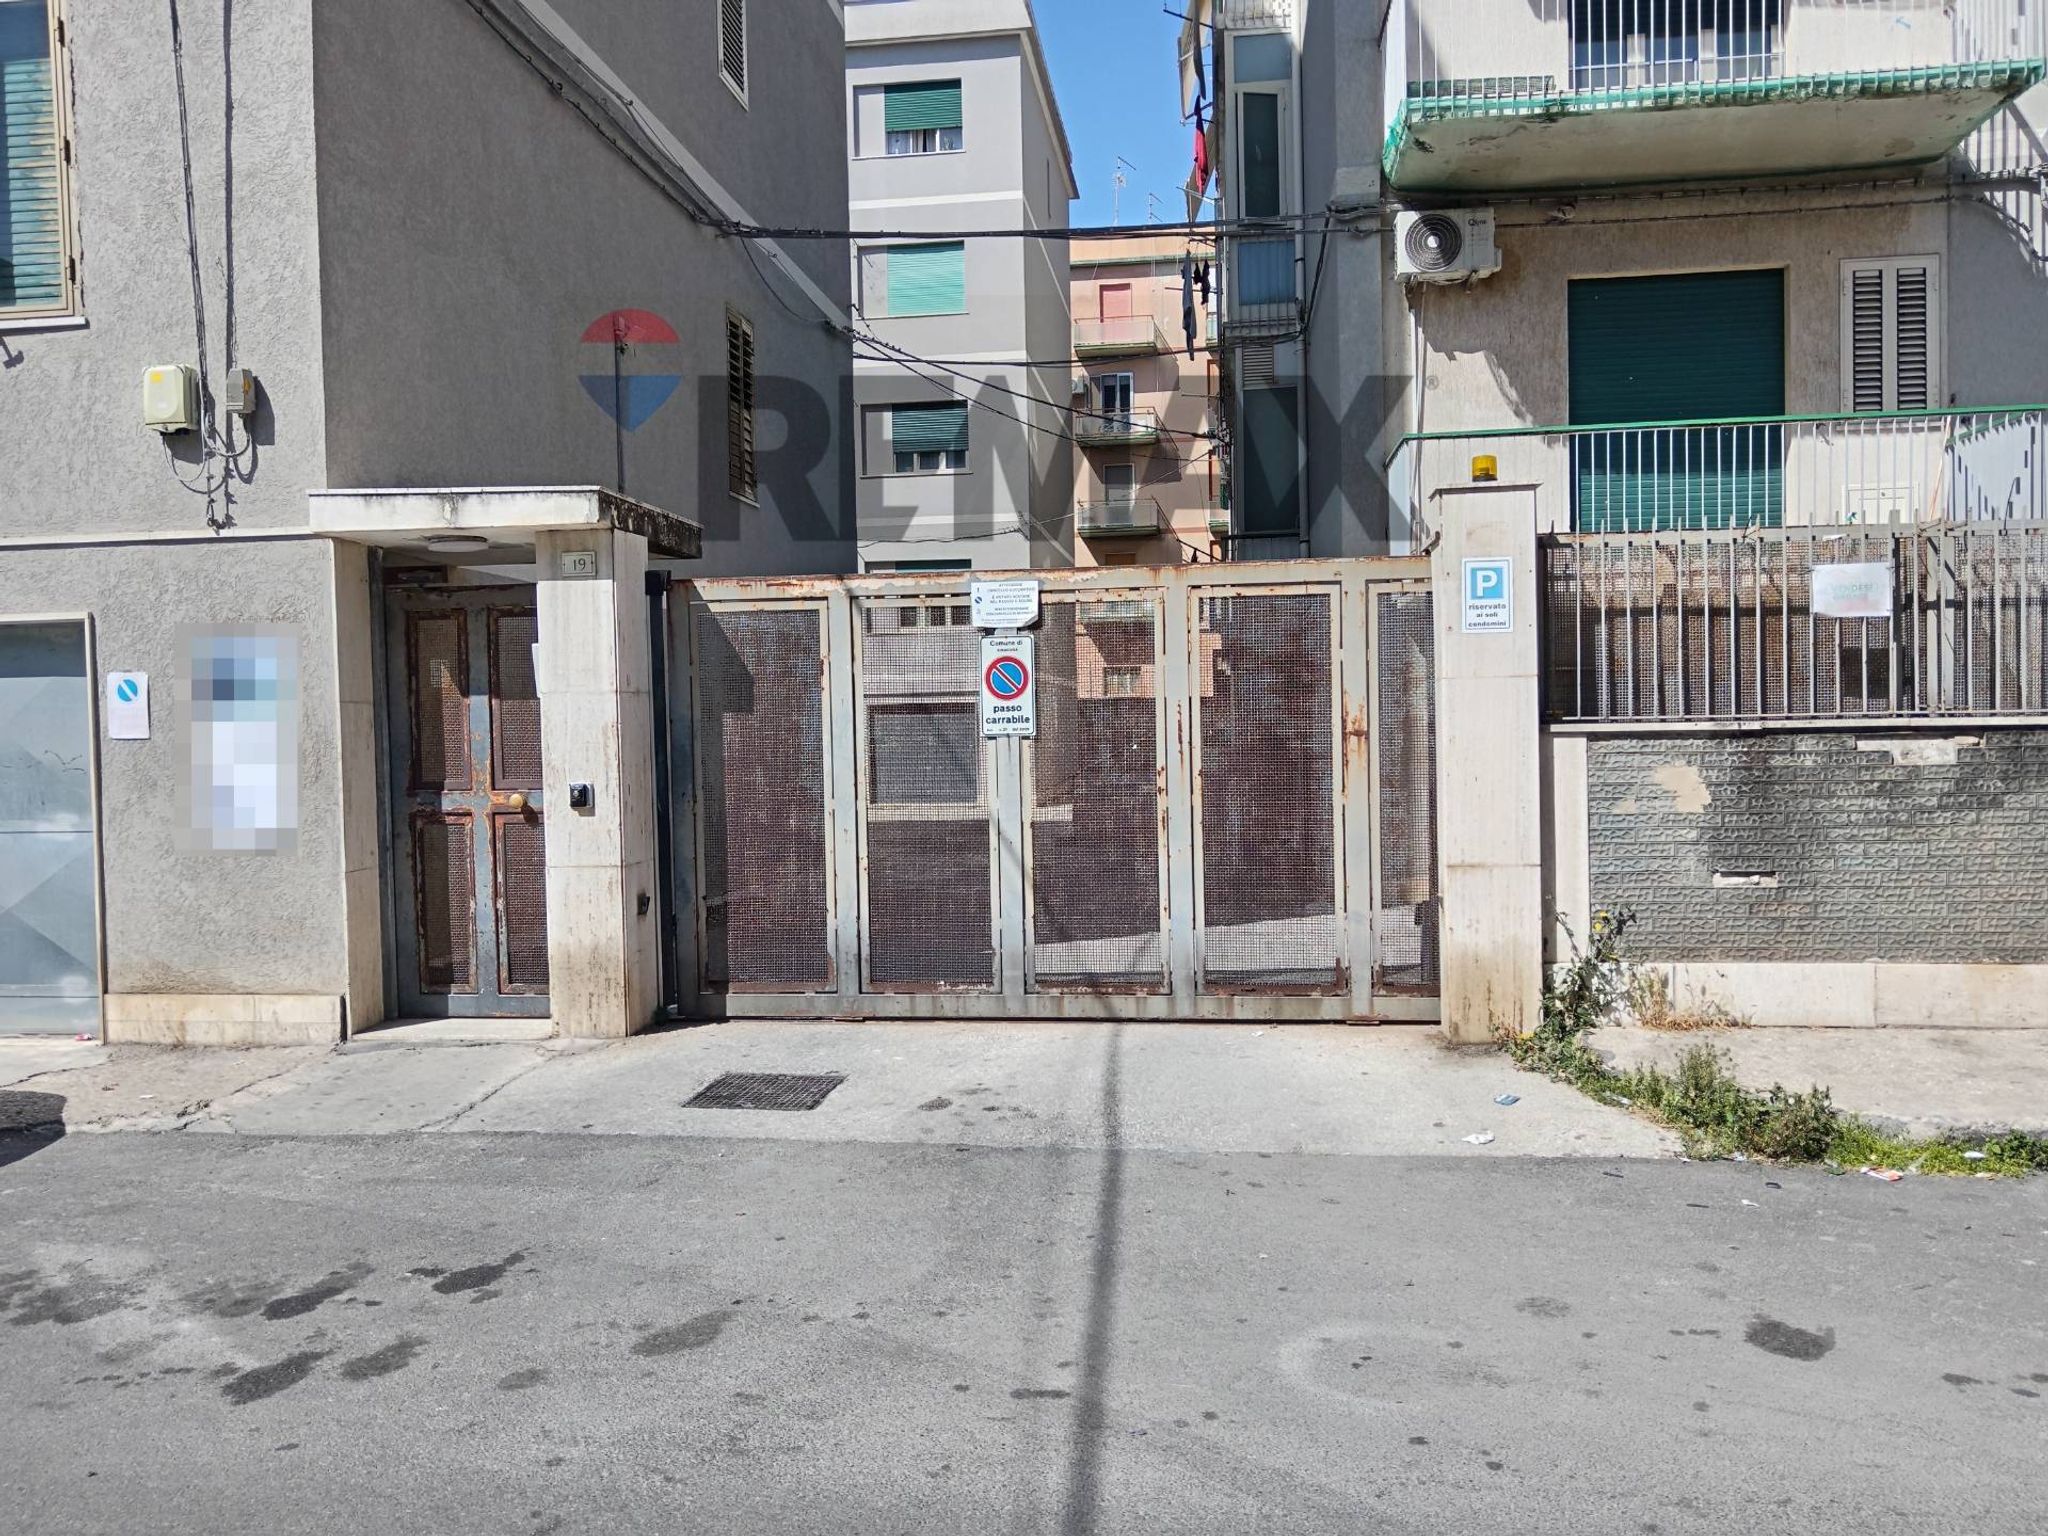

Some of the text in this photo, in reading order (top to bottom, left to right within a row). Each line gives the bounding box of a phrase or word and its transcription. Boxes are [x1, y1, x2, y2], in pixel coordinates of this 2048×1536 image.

[573, 558, 586, 571] 19
[1476, 570, 1498, 597] P
[1468, 603, 1506, 611] riservato
[993, 705, 1022, 714] passo
[985, 715, 1031, 725] carrabile
